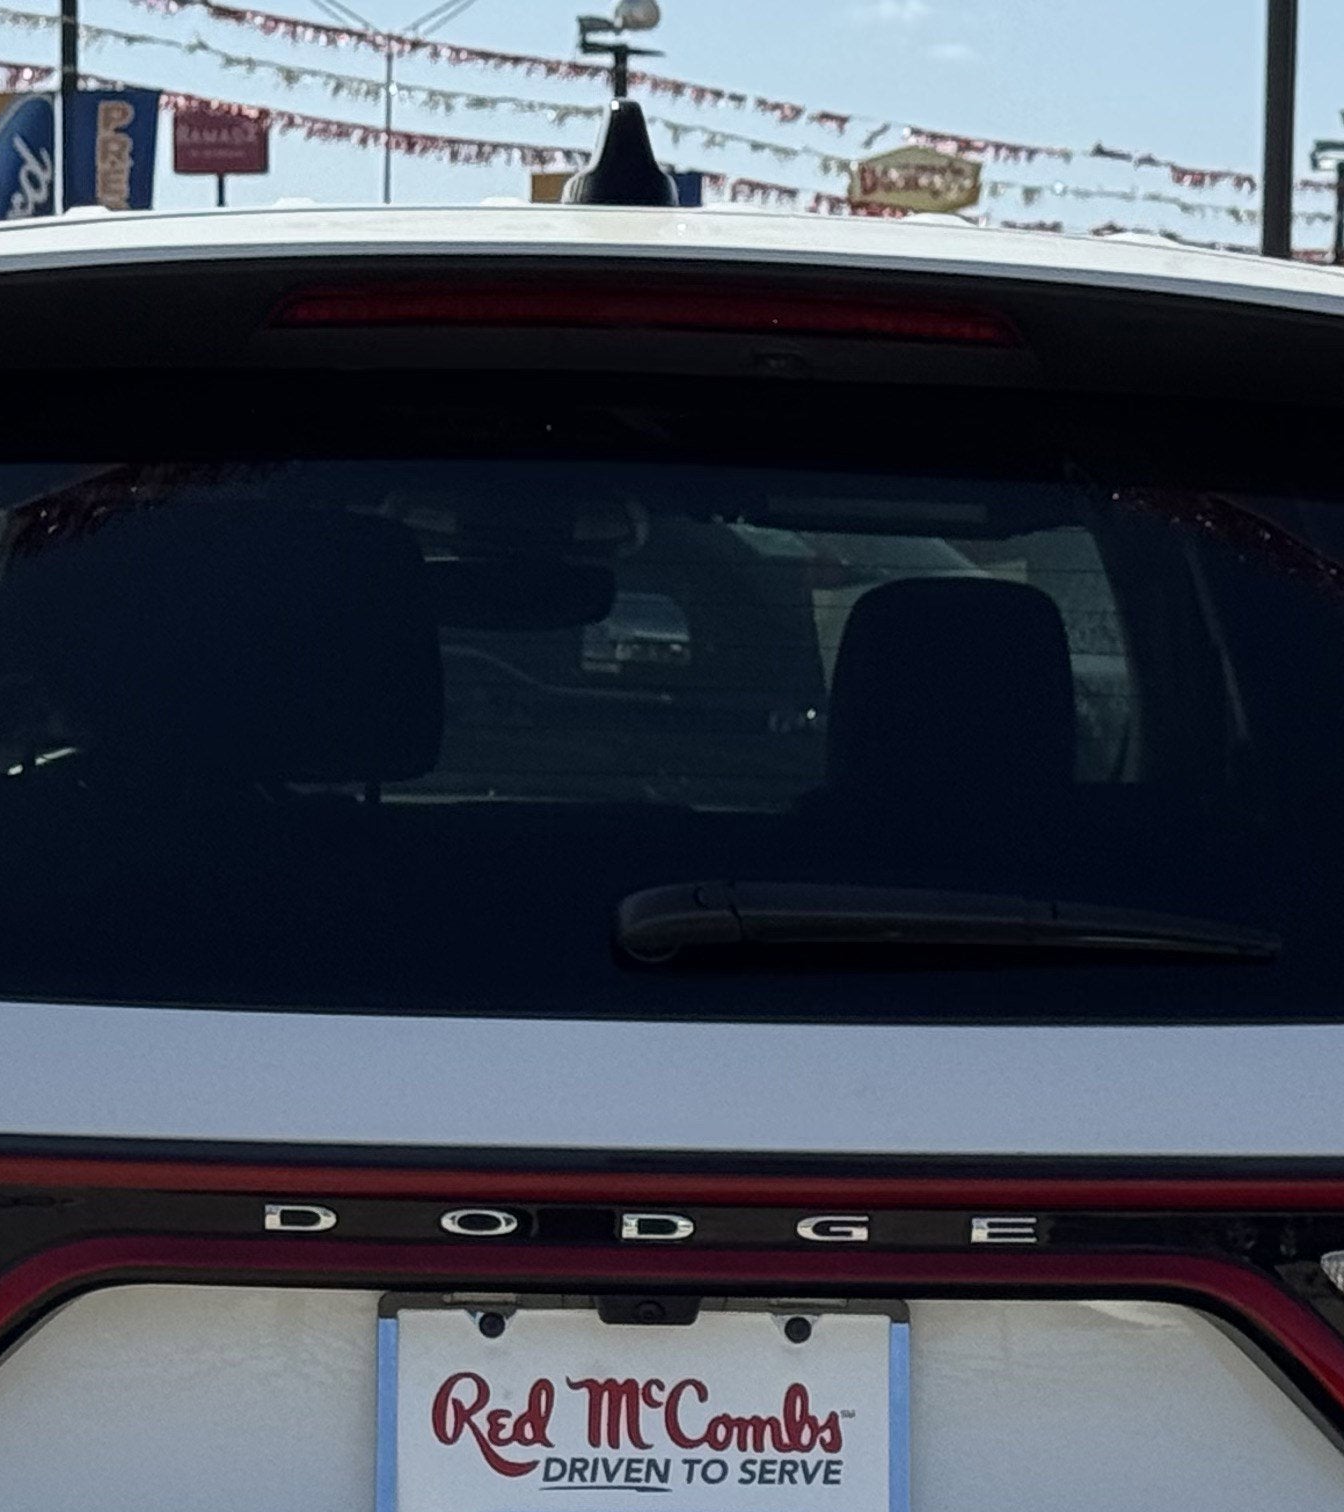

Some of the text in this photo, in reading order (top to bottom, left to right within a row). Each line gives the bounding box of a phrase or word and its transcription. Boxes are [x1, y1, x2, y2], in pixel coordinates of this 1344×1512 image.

[96, 100, 135, 210] PRE
[264, 1203, 1039, 1244] DODGE
[432, 1371, 555, 1477] Red
[565, 1376, 843, 1454] McCombs
[542, 1457, 844, 1485] DRIVEN TO SERVE
